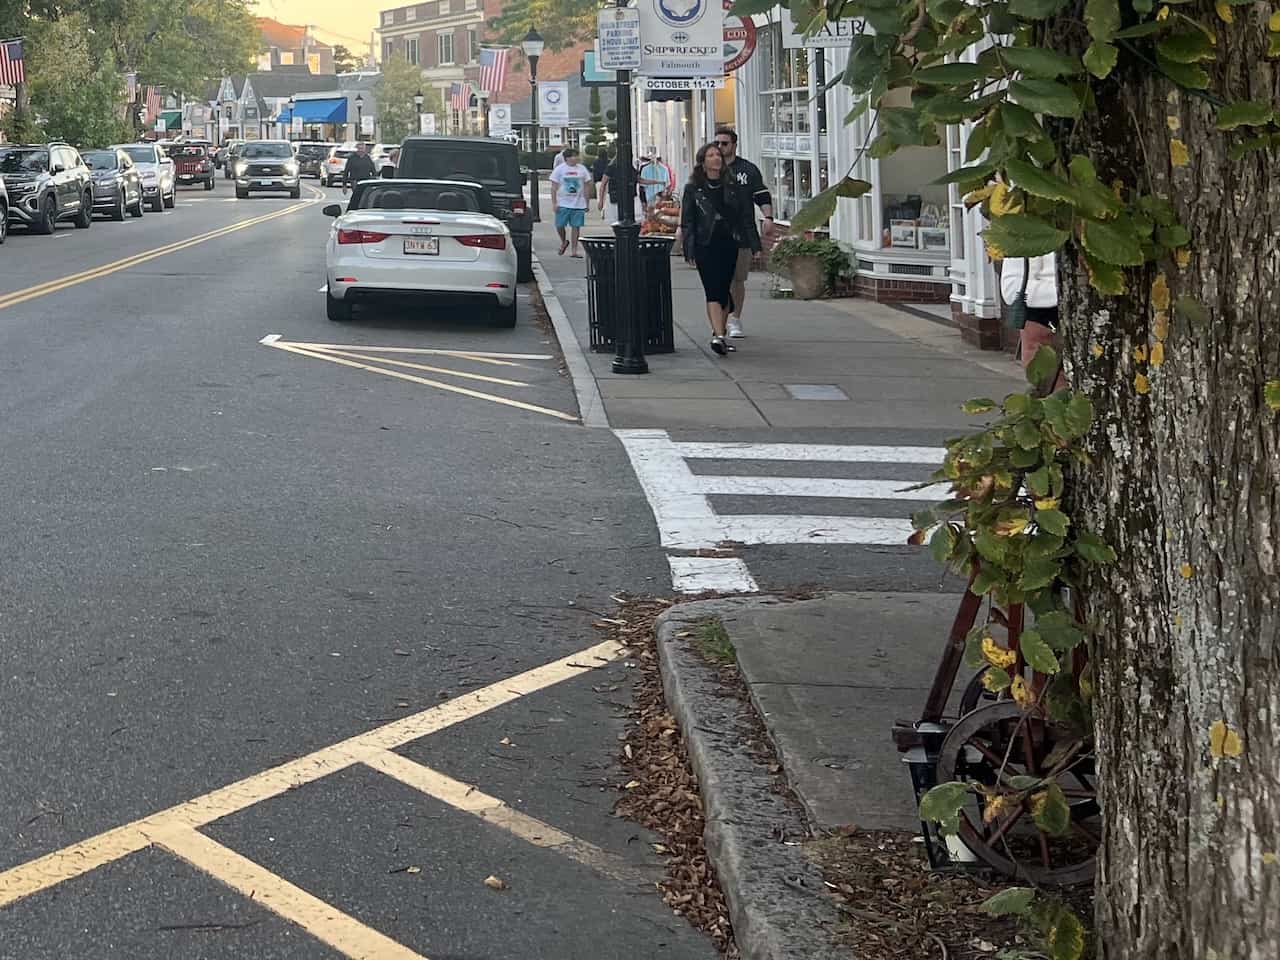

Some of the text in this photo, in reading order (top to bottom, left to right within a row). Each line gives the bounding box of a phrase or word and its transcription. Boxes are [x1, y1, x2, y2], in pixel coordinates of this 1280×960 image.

[727, 30, 748, 39] COD
[661, 60, 701, 69] Falmouth
[647, 80, 716, 89] OCTOBER 11-12
